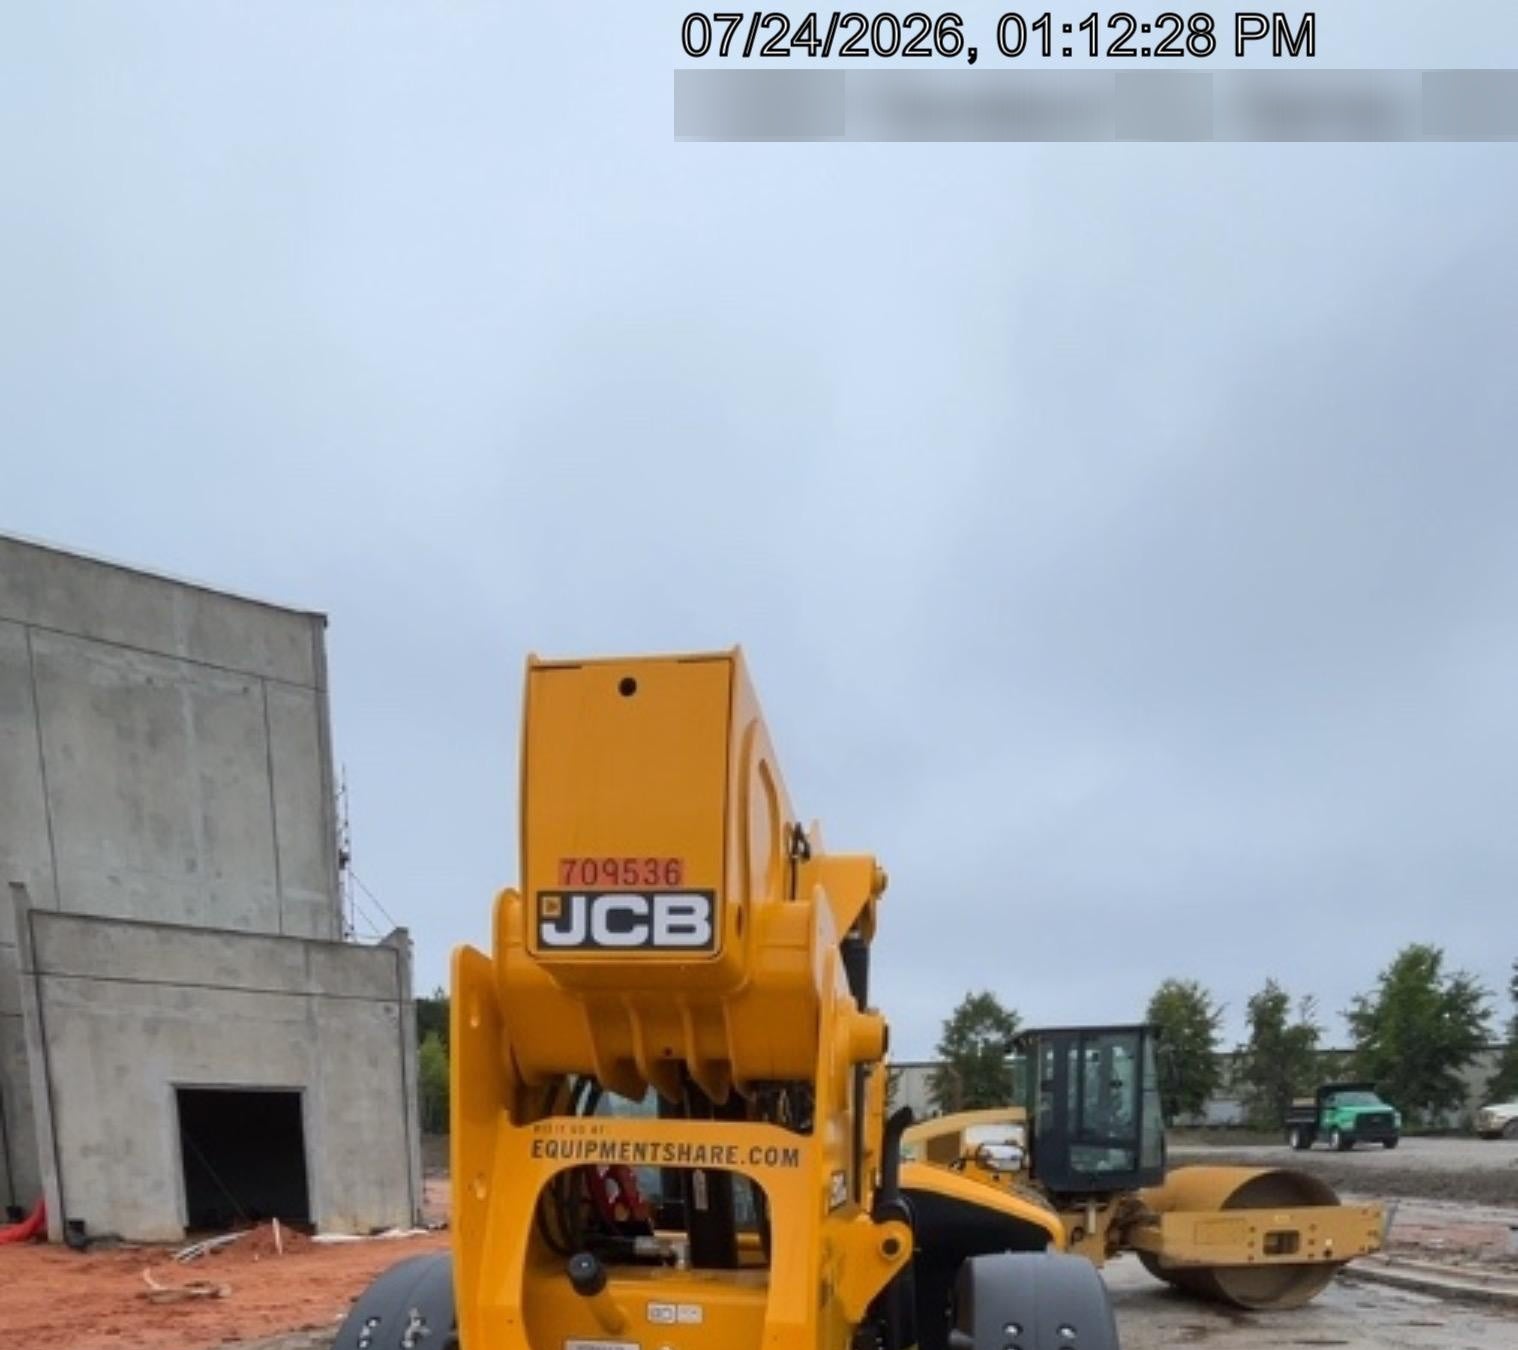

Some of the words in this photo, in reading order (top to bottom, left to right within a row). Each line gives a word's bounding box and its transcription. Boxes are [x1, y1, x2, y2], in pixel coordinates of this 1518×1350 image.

[559, 857, 682, 886] 709536
[541, 893, 712, 946] JCB
[531, 1138, 800, 1168] EQUIPMENTSHARE.COM
